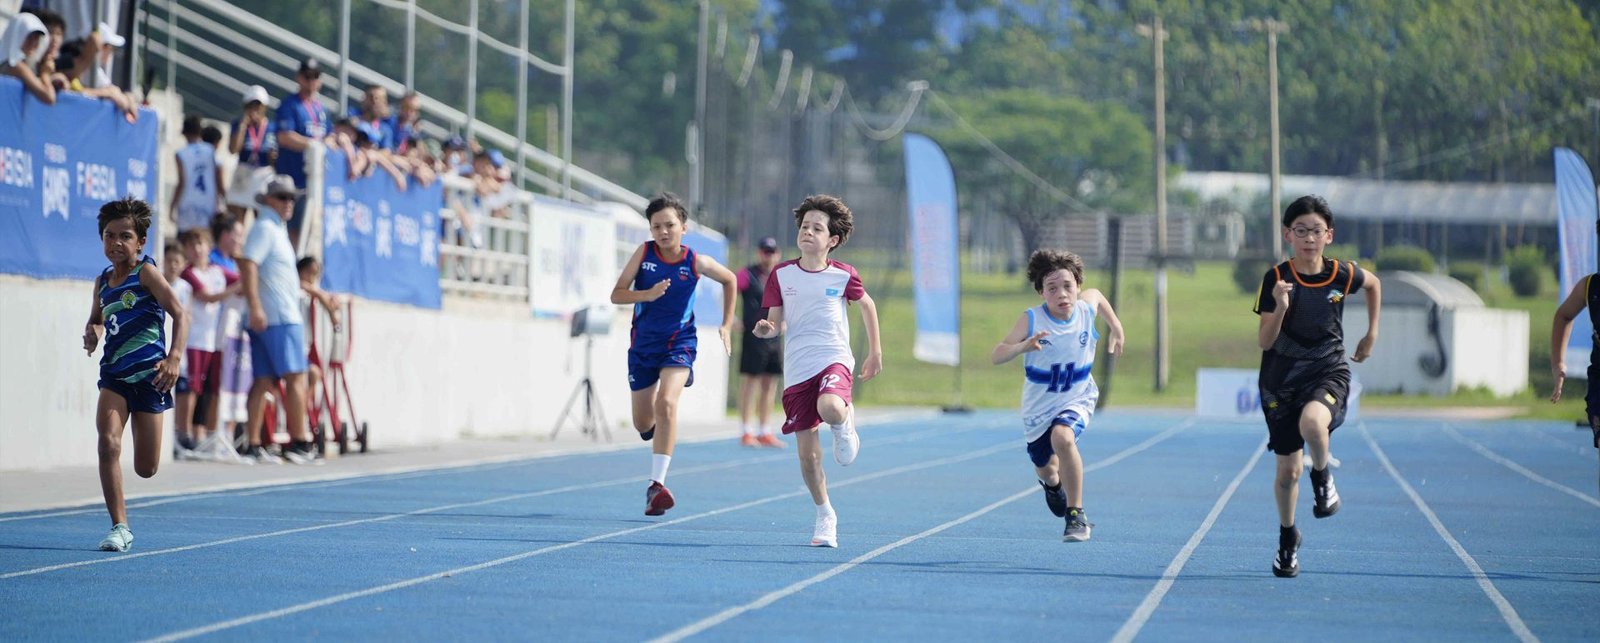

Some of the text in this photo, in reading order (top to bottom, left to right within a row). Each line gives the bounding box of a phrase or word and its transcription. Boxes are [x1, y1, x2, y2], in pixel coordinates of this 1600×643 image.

[641, 261, 658, 272] STC
[108, 314, 120, 336] 3
[1047, 361, 1076, 393] 11
